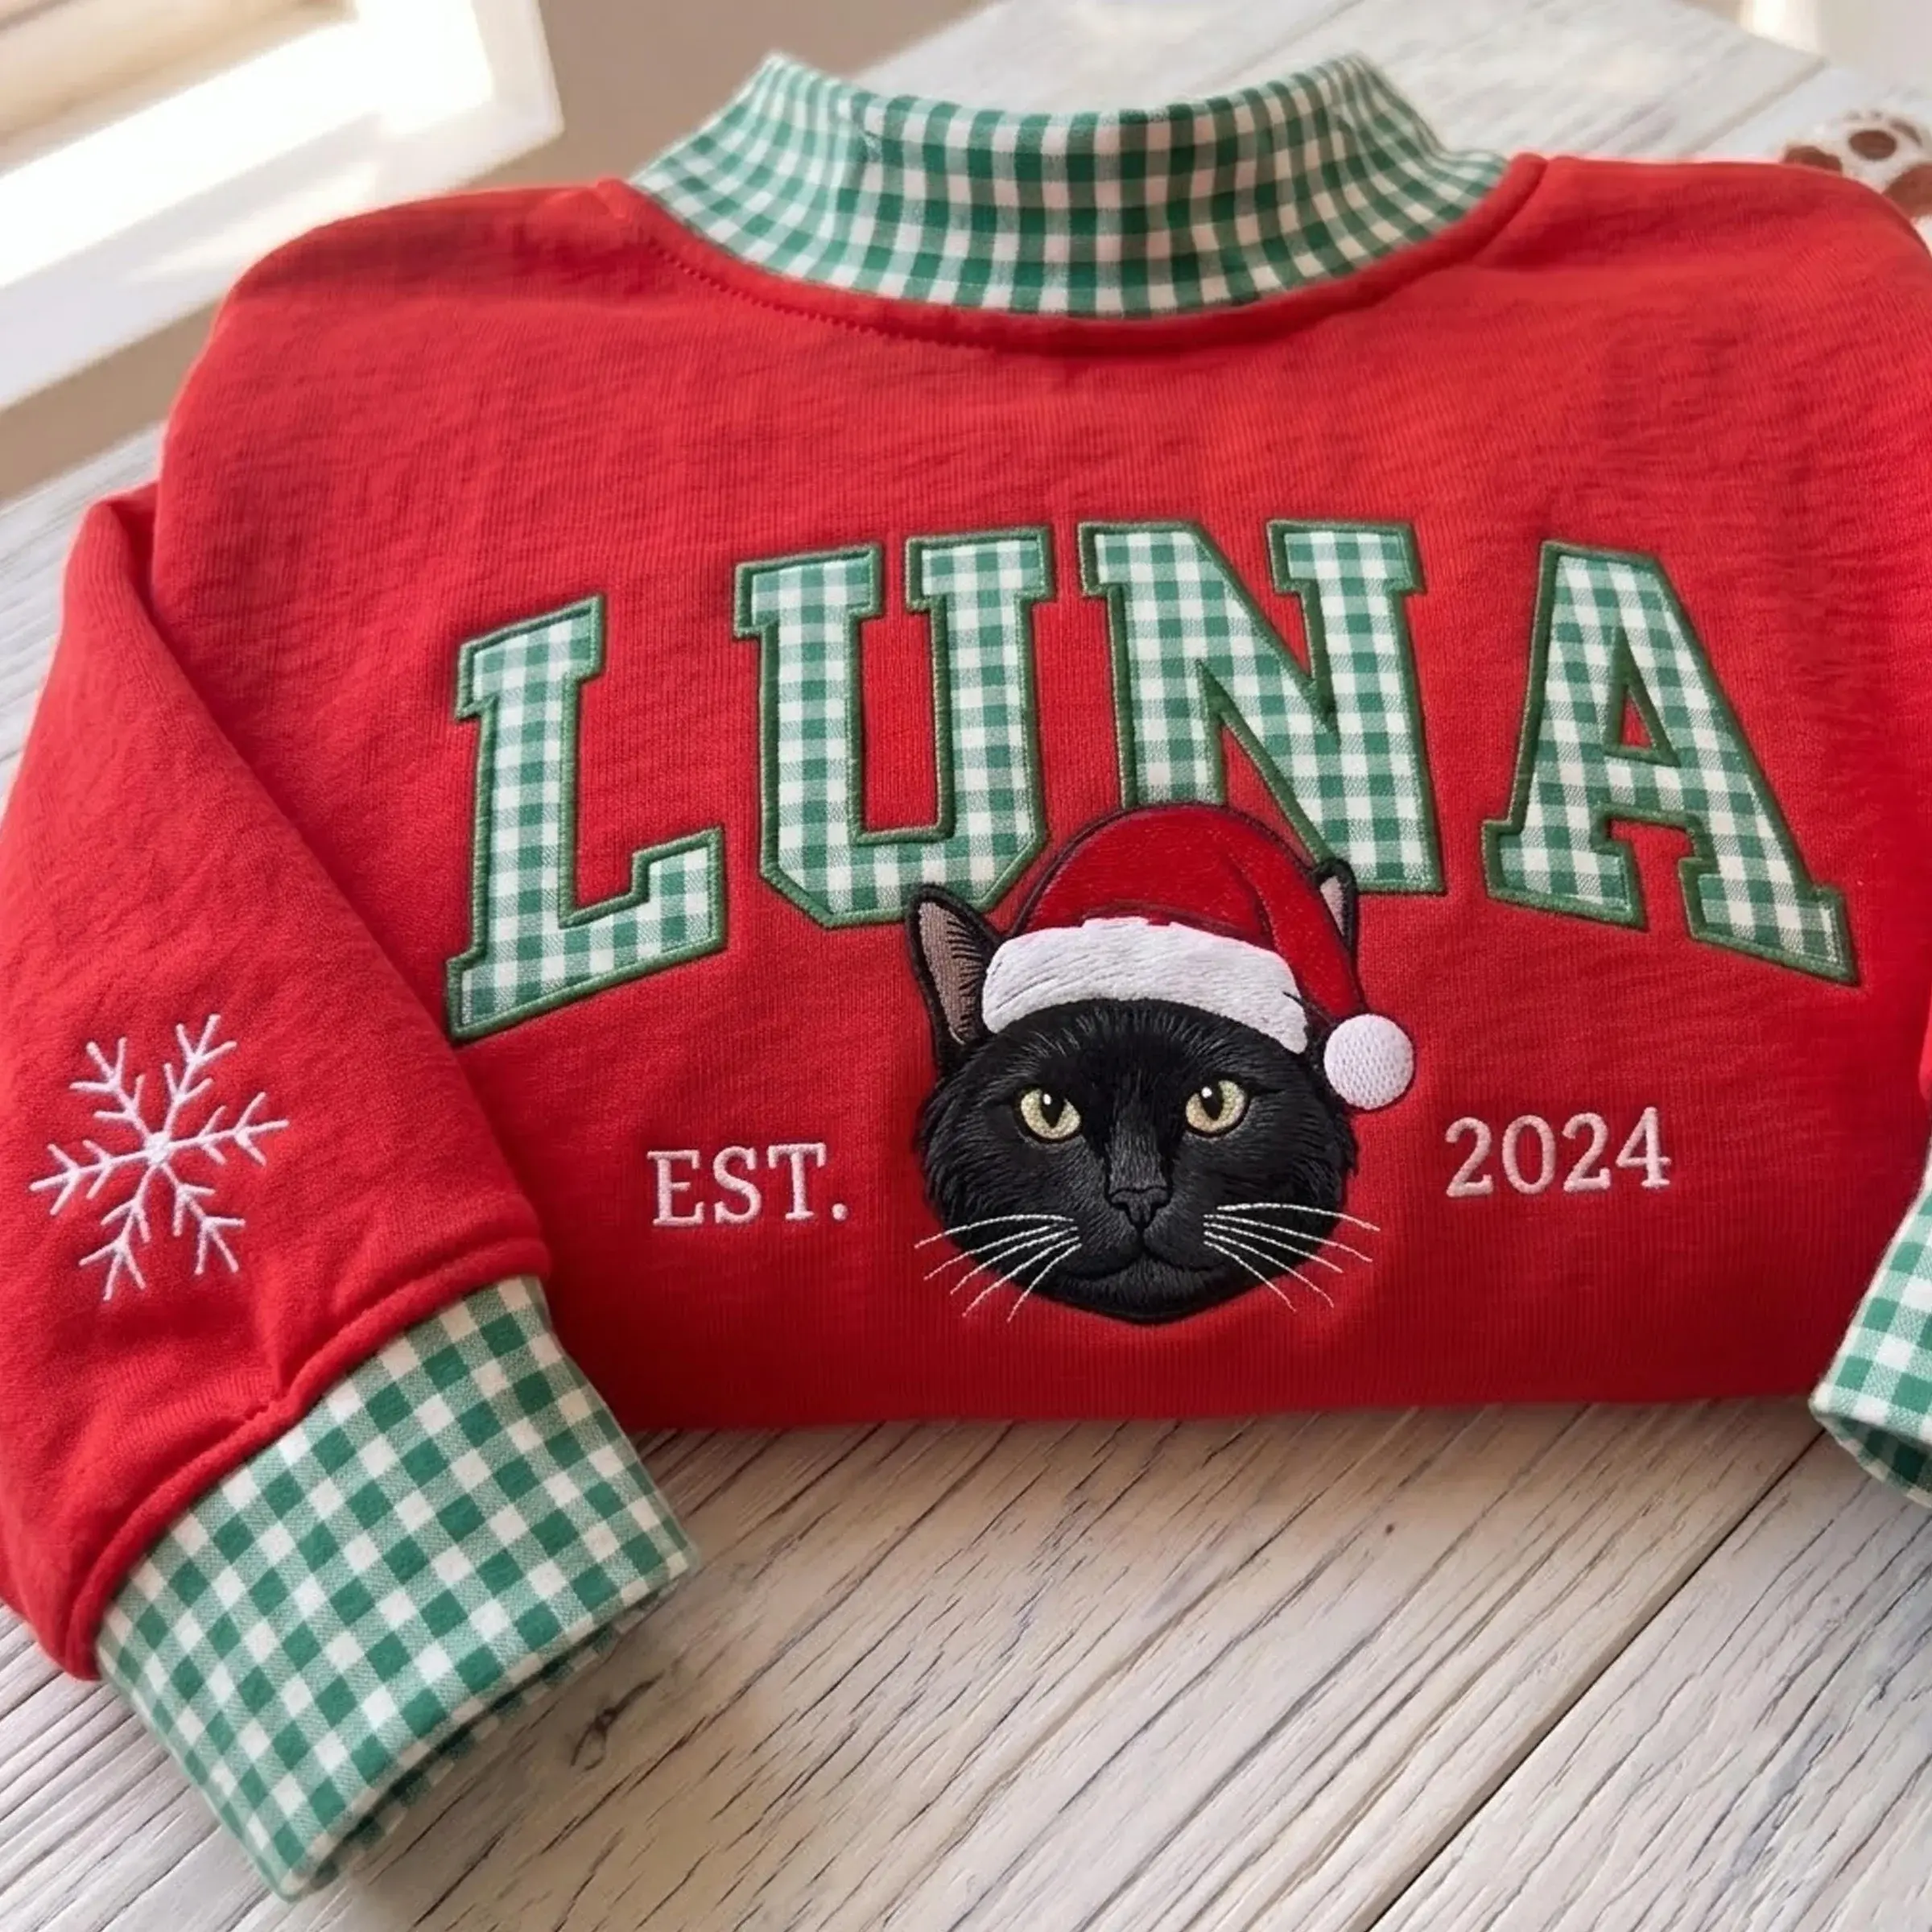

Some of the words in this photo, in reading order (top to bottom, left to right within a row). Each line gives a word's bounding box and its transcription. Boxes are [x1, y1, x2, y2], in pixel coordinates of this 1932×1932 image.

[449, 519, 1859, 1042] LUNA
[647, 1142, 849, 1226] EST.
[1445, 1106, 1672, 1198] 2024
